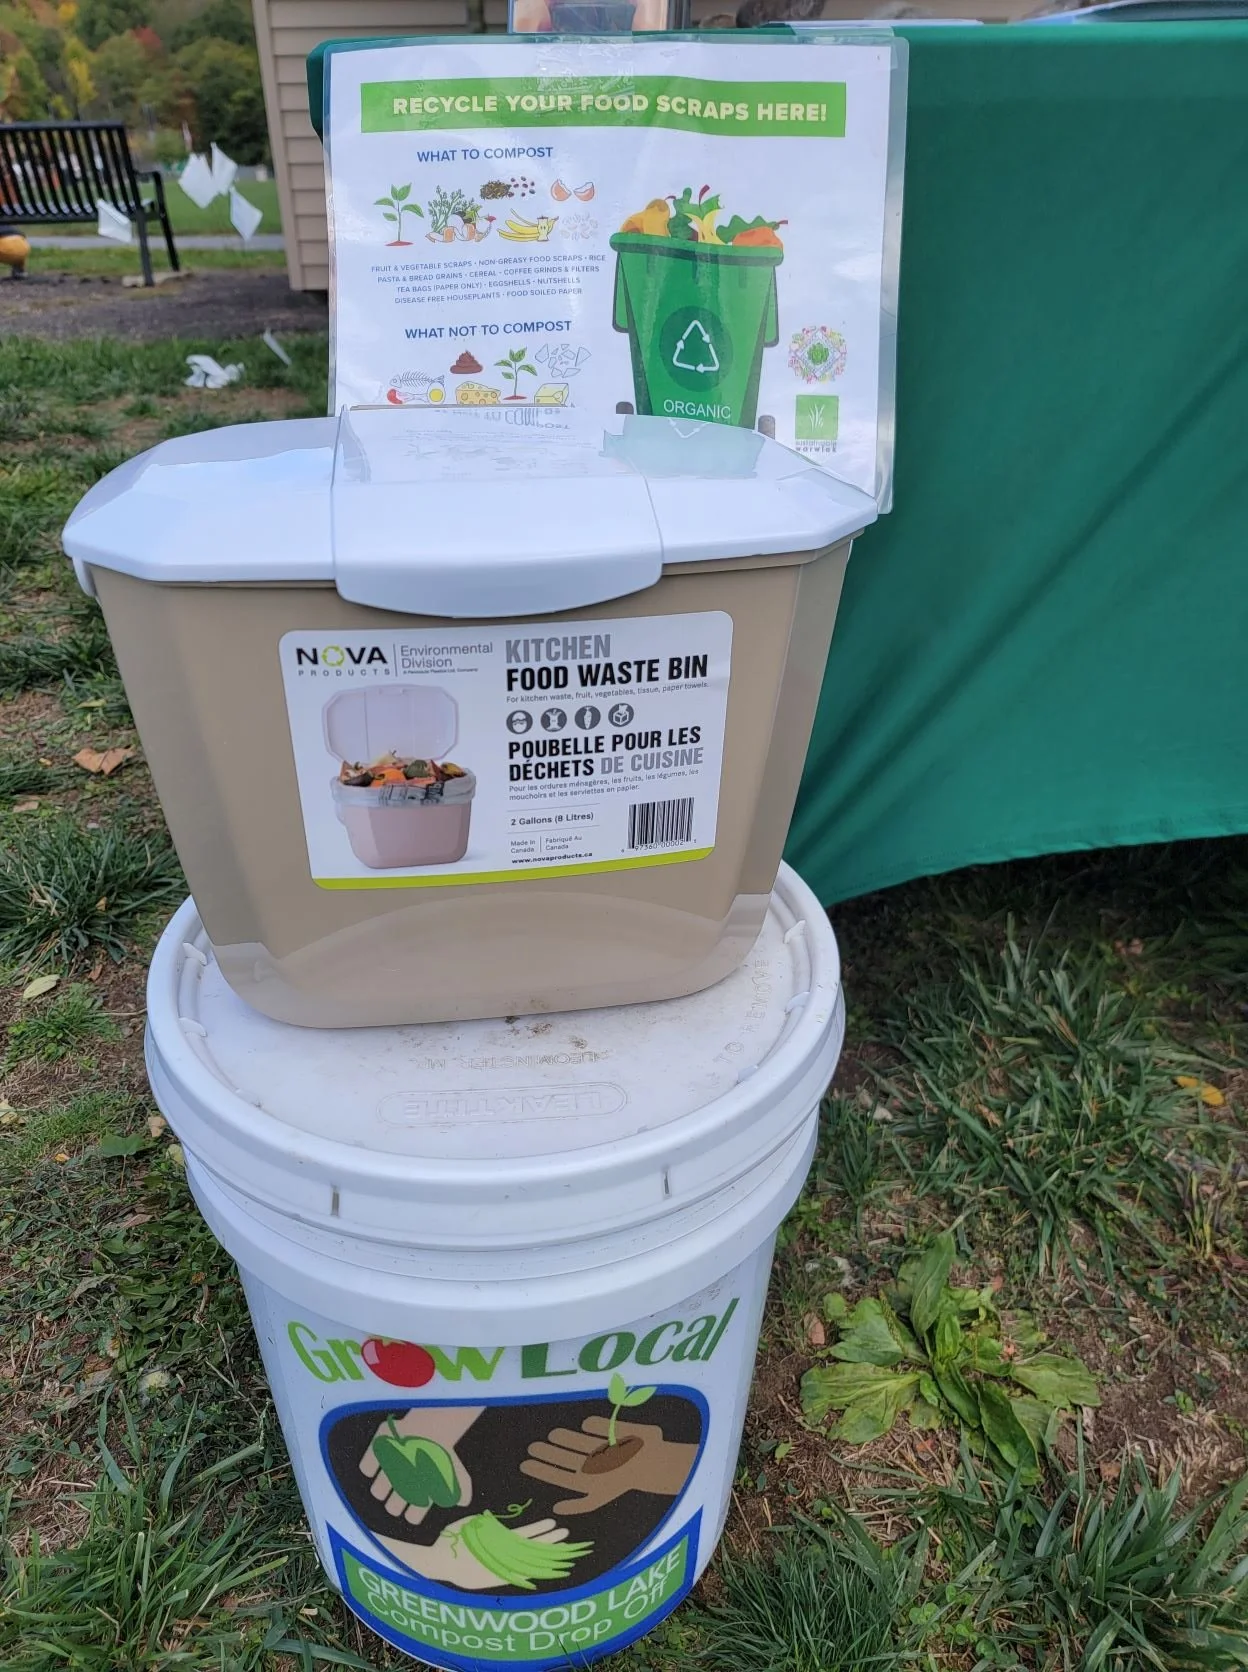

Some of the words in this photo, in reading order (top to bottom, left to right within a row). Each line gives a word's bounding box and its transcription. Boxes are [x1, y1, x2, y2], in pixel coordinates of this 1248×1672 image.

[393, 95, 498, 115] RECYCLE
[505, 95, 572, 112] YOUR
[580, 94, 649, 112] FOOD
[656, 94, 749, 121] SCRAPS
[757, 103, 827, 122] HERE!
[417, 149, 458, 163] WHAT
[461, 148, 480, 161] TO
[484, 146, 554, 160] COMPOST
[371, 265, 392, 273] FRUIT
[400, 262, 442, 272] VEGETABLE
[443, 260, 472, 269] SCRAPS
[478, 257, 527, 267] NON-GREASY
[552, 254, 583, 262] SCRAPS
[377, 276, 401, 284] PASTA
[408, 274, 434, 282] BREAD
[435, 273, 463, 281] GRAINS
[469, 270, 497, 278] CEREAL
[503, 267, 532, 276] COFFEE
[534, 266, 563, 274] GRINDS
[571, 265, 600, 273] FILTERS
[397, 286, 410, 294] TEA
[412, 285, 432, 293] BAGS
[433, 283, 459, 292] (PAPER
[460, 281, 482, 290] ONLY)
[488, 278, 531, 288] EGGSHELLS
[537, 277, 581, 285] NUTSHELLS
[394, 296, 426, 304] DISEASE
[427, 295, 445, 303] FREE
[446, 291, 501, 301] HOUSEPLANTS
[530, 288, 557, 296] SOILED
[558, 287, 583, 295] PAPER
[405, 327, 445, 339] WHAT
[448, 325, 477, 338] NOT
[480, 324, 500, 336] TO
[503, 320, 572, 334] COMPOST
[663, 399, 731, 420] ORGANIC
[296, 644, 388, 667] NOVA
[400, 642, 493, 657] Environmental
[505, 634, 611, 664] KITCHEN
[401, 656, 453, 669] Division
[298, 669, 390, 677] PRODUCTS
[506, 665, 569, 692] FOOD
[577, 658, 660, 688] WASTE
[667, 654, 708, 681] BIN
[506, 696, 518, 704] For
[520, 694, 548, 702] kitchen
[549, 693, 574, 701] waste,
[575, 691, 593, 699] fruit,
[594, 688, 636, 698] vegetables,
[662, 684, 684, 694] paper
[684, 681, 709, 690] towels.
[508, 735, 605, 760] POUBELLE
[612, 730, 662, 752] POUR
[667, 725, 701, 746] LES
[509, 757, 595, 782] DÉCHETS
[600, 755, 624, 775] DE
[630, 747, 704, 772] CUISINE
[508, 785, 526, 793] Pour
[539, 782, 567, 790] ordures
[568, 779, 610, 788] ménagères,
[611, 776, 622, 784] les
[623, 775, 644, 783] fruits,
[688, 768, 699, 776] les
[509, 792, 547, 801] mouchoirs
[569, 787, 605, 796] serviettes
[616, 784, 640, 793] papier.
[510, 818, 516, 826] 2
[518, 816, 553, 825] Gallons
[554, 814, 563, 824] (8
[565, 812, 594, 822] Litres)
[545, 836, 573, 844] Fabriqué
[511, 852, 593, 864] www.novaproducts.ca
[521, 1298, 740, 1378] Local
[358, 1567, 597, 1633] GREENWOOD
[607, 1546, 681, 1613] LAKE
[367, 1591, 516, 1652] Compost
[529, 1617, 613, 1652] Drop
[623, 1578, 669, 1621] Off
